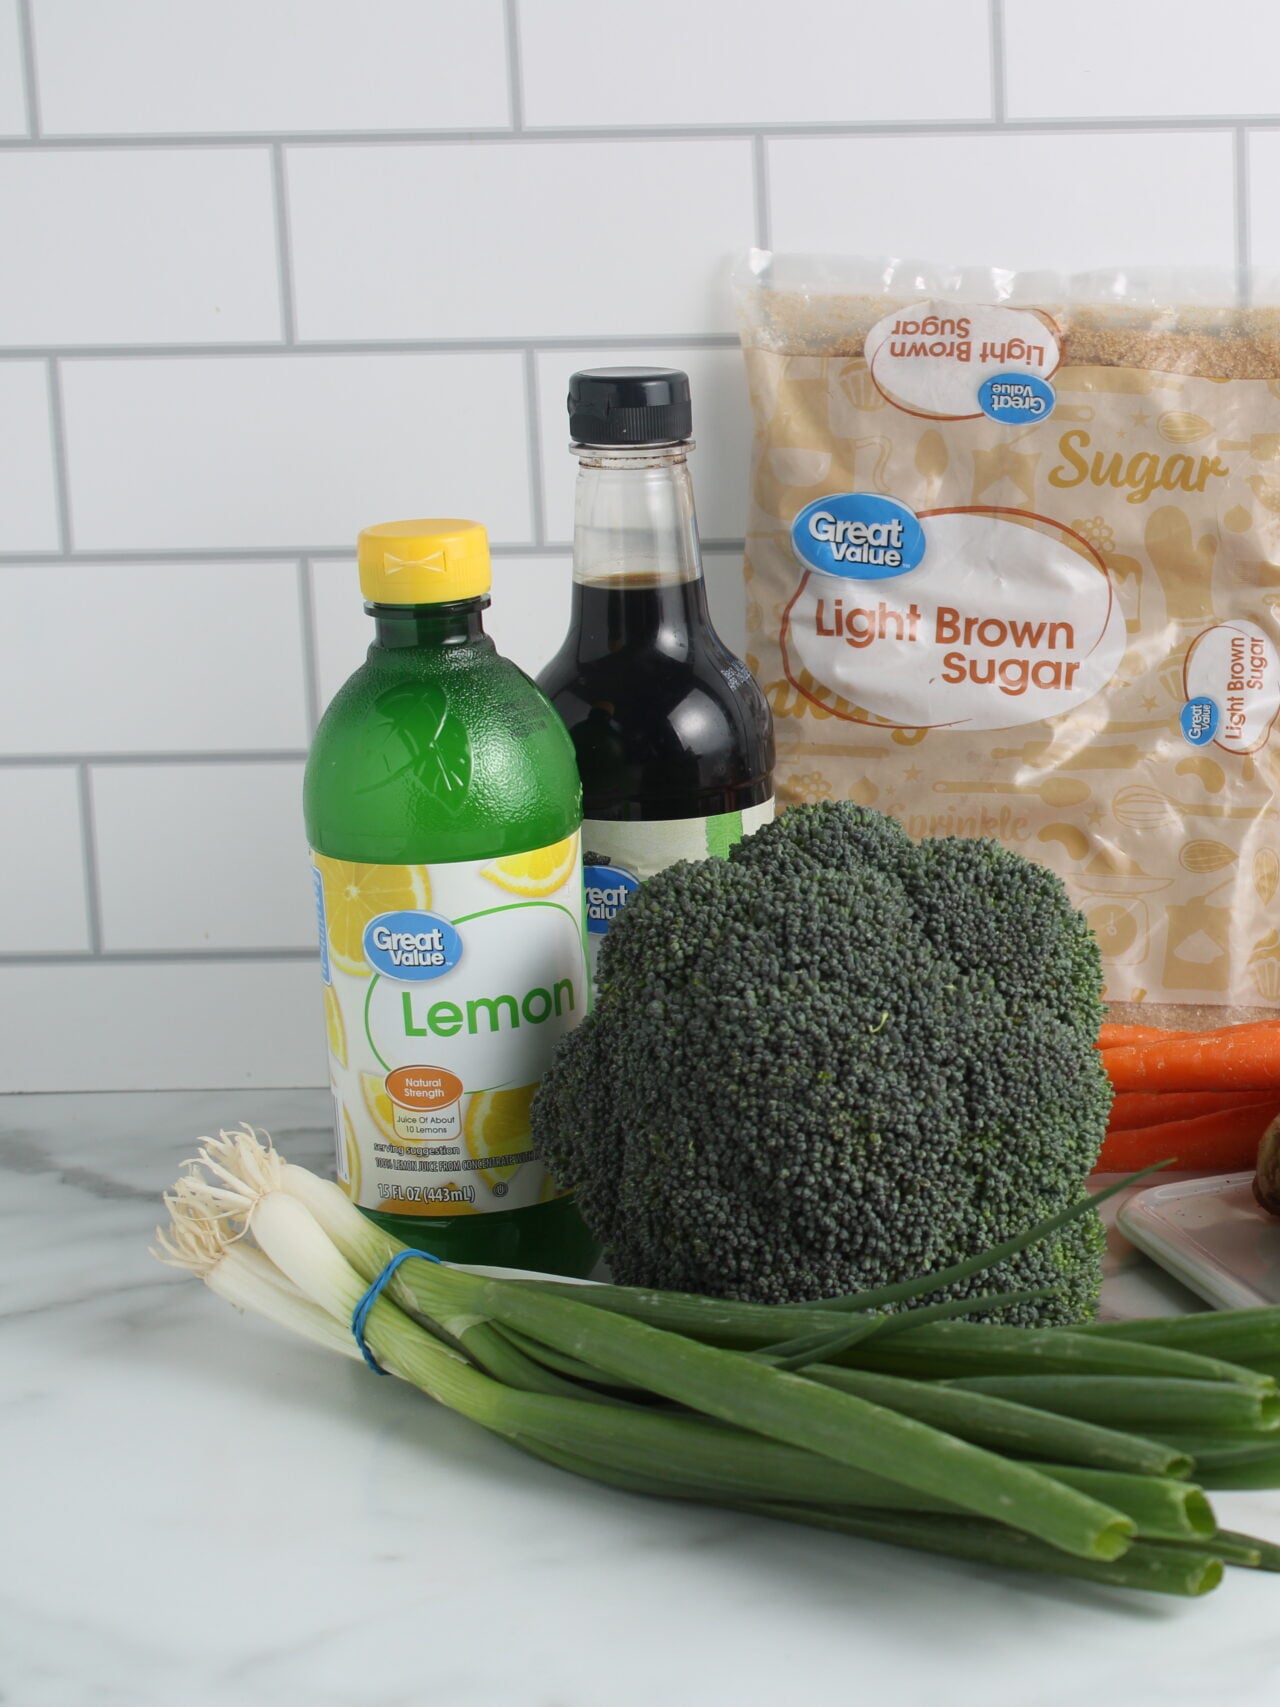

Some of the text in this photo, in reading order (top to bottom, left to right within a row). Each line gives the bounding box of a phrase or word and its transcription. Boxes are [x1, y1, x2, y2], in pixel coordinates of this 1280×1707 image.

[891, 316, 971, 338] Sugar
[890, 338, 1046, 366] Light Brown
[992, 384, 1033, 397] Value
[992, 395, 1046, 414] Great
[1048, 430, 1229, 504] Sugar
[808, 511, 904, 549] Great
[830, 542, 902, 567] Value
[815, 599, 1074, 650] Light Brown
[941, 652, 1080, 696] Sugar
[1247, 637, 1268, 690] Sugar
[1225, 637, 1246, 740] Light Brown
[1188, 704, 1203, 740] Great
[1201, 704, 1211, 731] Value
[584, 885, 629, 905] reat
[587, 904, 617, 919] alu
[372, 926, 445, 952] Great
[389, 948, 446, 967] Value
[402, 978, 575, 1037] Lemon
[404, 1088, 445, 1099] Strength
[405, 1078, 442, 1087] Natural
[397, 1116, 455, 1124] Juice Of About
[416, 1126, 447, 1134] Lemons
[374, 1143, 460, 1157] serving suggestion
[393, 1159, 417, 1171] LEMON
[417, 1160, 438, 1172] JUICE
[439, 1160, 461, 1172] FROM
[378, 1183, 390, 1198] 15
[392, 1184, 404, 1200] FL
[406, 1186, 421, 1201] OZ
